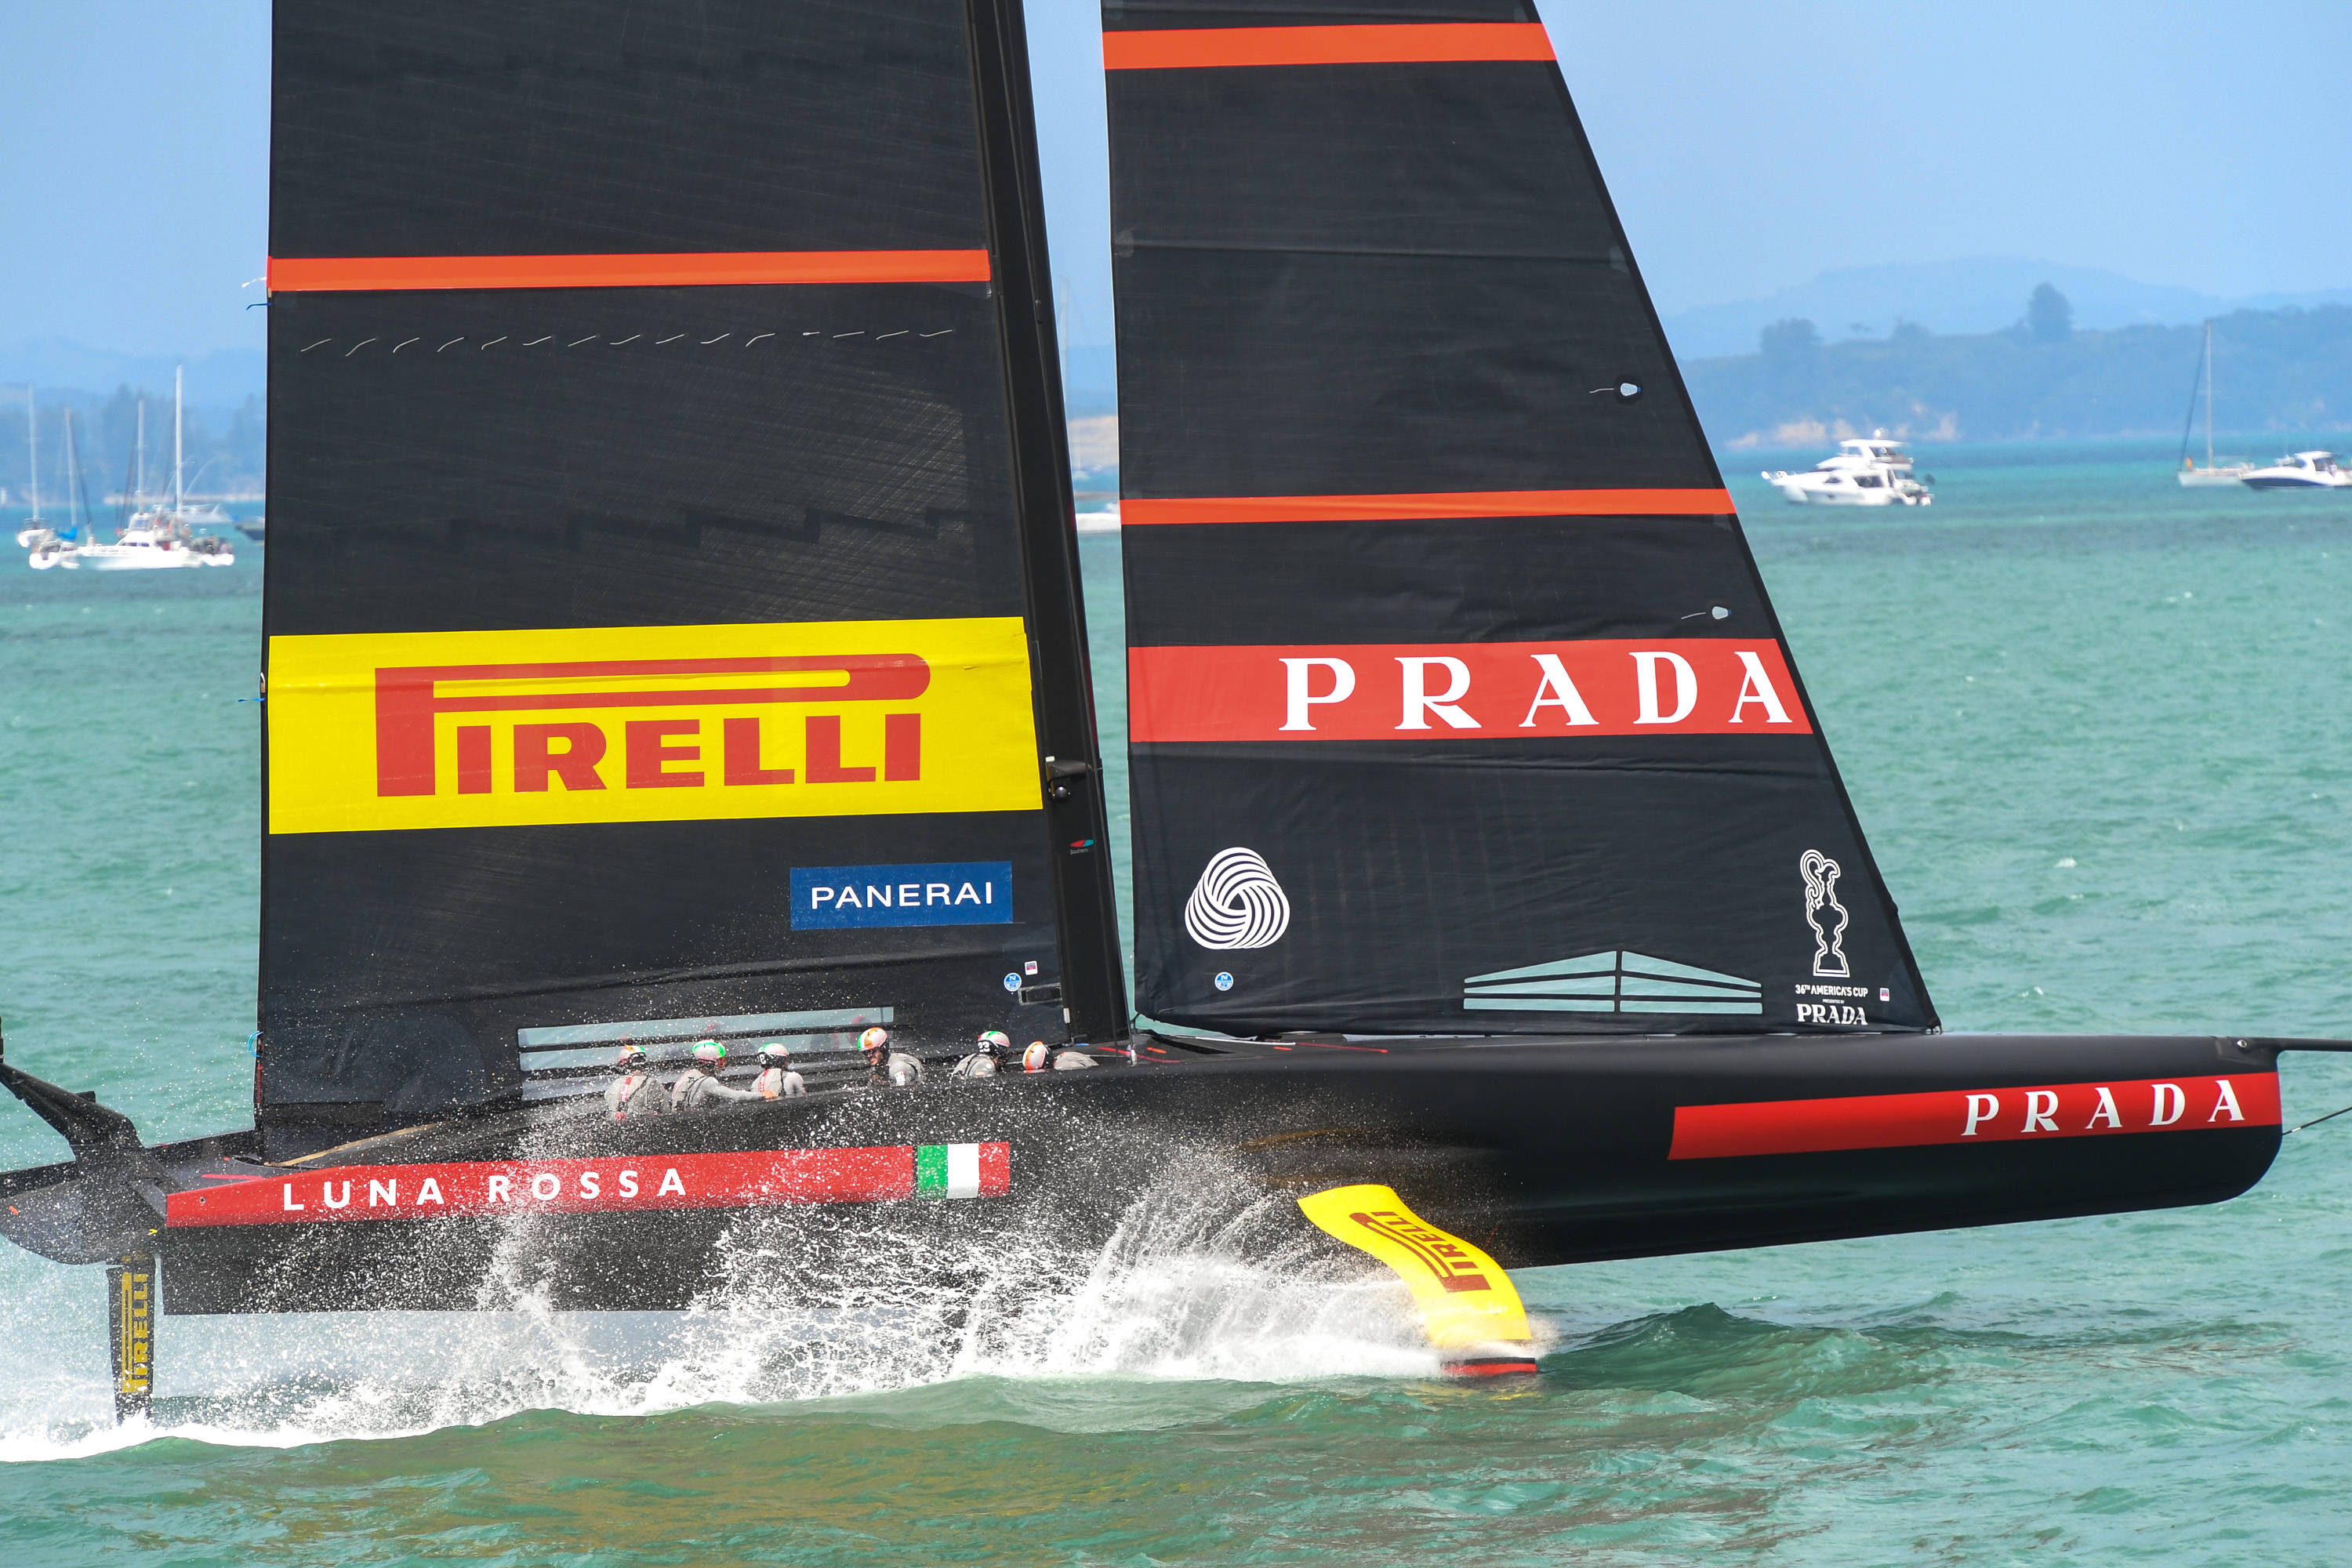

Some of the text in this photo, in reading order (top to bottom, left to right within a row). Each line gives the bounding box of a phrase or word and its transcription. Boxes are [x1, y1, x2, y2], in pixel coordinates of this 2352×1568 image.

[1279, 652, 1792, 731] PRADA
[376, 654, 931, 797] PIRELLI
[811, 881, 993, 909] PANERAI
[1795, 1004, 1868, 1025] PRADA
[1811, 985, 1852, 996] AMERICA'S
[1853, 987, 1869, 997] CUP
[1961, 1080, 2245, 1136] PRADA
[283, 1167, 686, 1211] LUNA ROSSA
[1349, 1211, 1491, 1292] PIRELLI
[122, 1272, 148, 1392] PIRELLI
